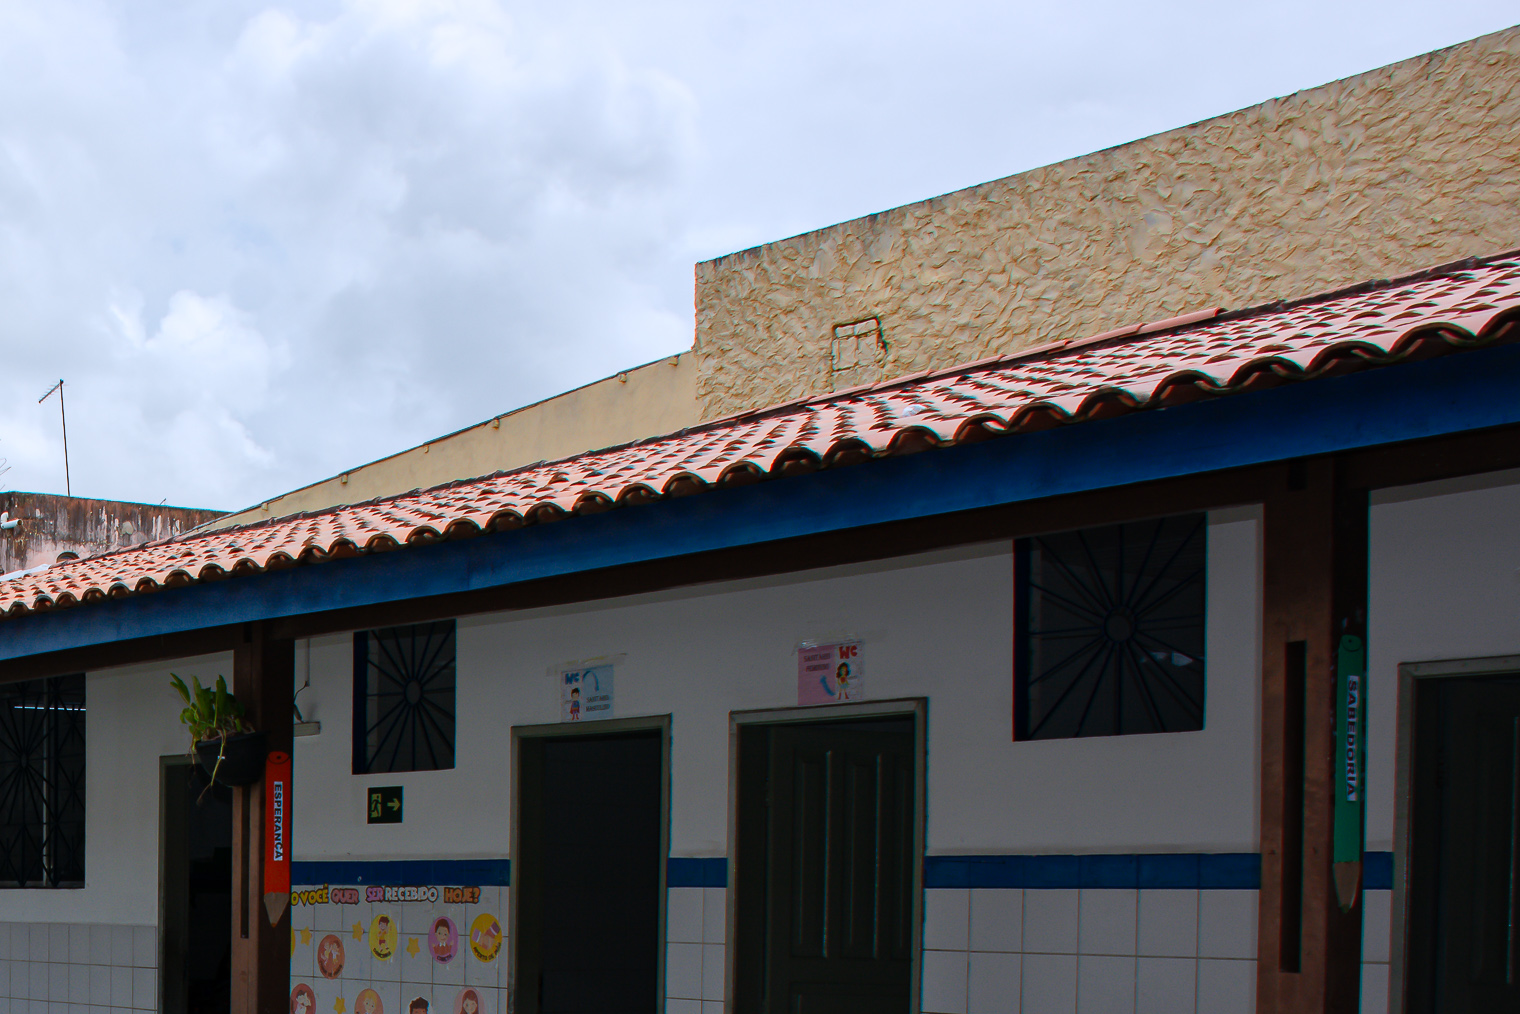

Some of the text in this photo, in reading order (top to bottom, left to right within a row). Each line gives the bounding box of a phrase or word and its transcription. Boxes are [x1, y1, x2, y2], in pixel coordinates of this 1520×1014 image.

[839, 645, 858, 659] WC
[564, 672, 580, 685] WC
[1346, 680, 1357, 796] SABEDORIA
[331, 888, 360, 905] QUER
[365, 886, 384, 903] SER
[383, 885, 439, 903] RECEBIDO
[443, 886, 481, 904] HOJE?
